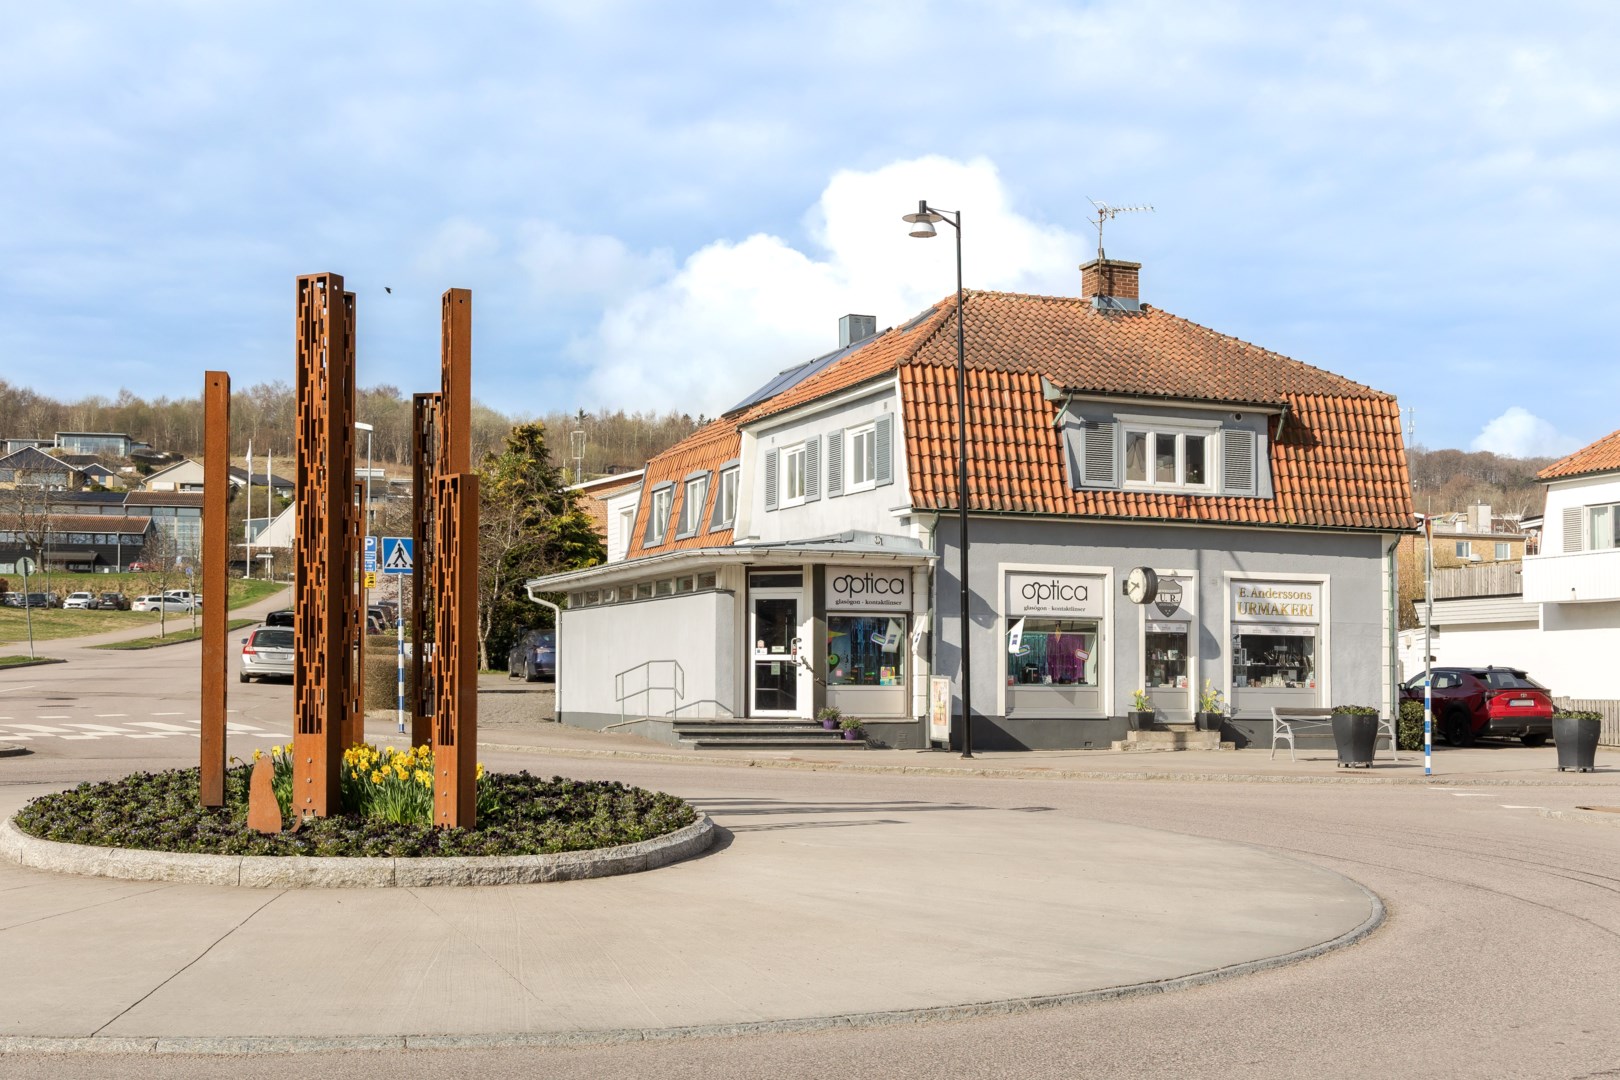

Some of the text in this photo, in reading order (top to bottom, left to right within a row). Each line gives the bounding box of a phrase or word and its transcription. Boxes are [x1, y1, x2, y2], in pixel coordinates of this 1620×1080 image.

[365, 538, 374, 550] P
[833, 572, 904, 598] optica
[1022, 580, 1088, 605] optica
[1239, 587, 1312, 600] E. Anderssons
[1237, 601, 1314, 617] URMAKERI
